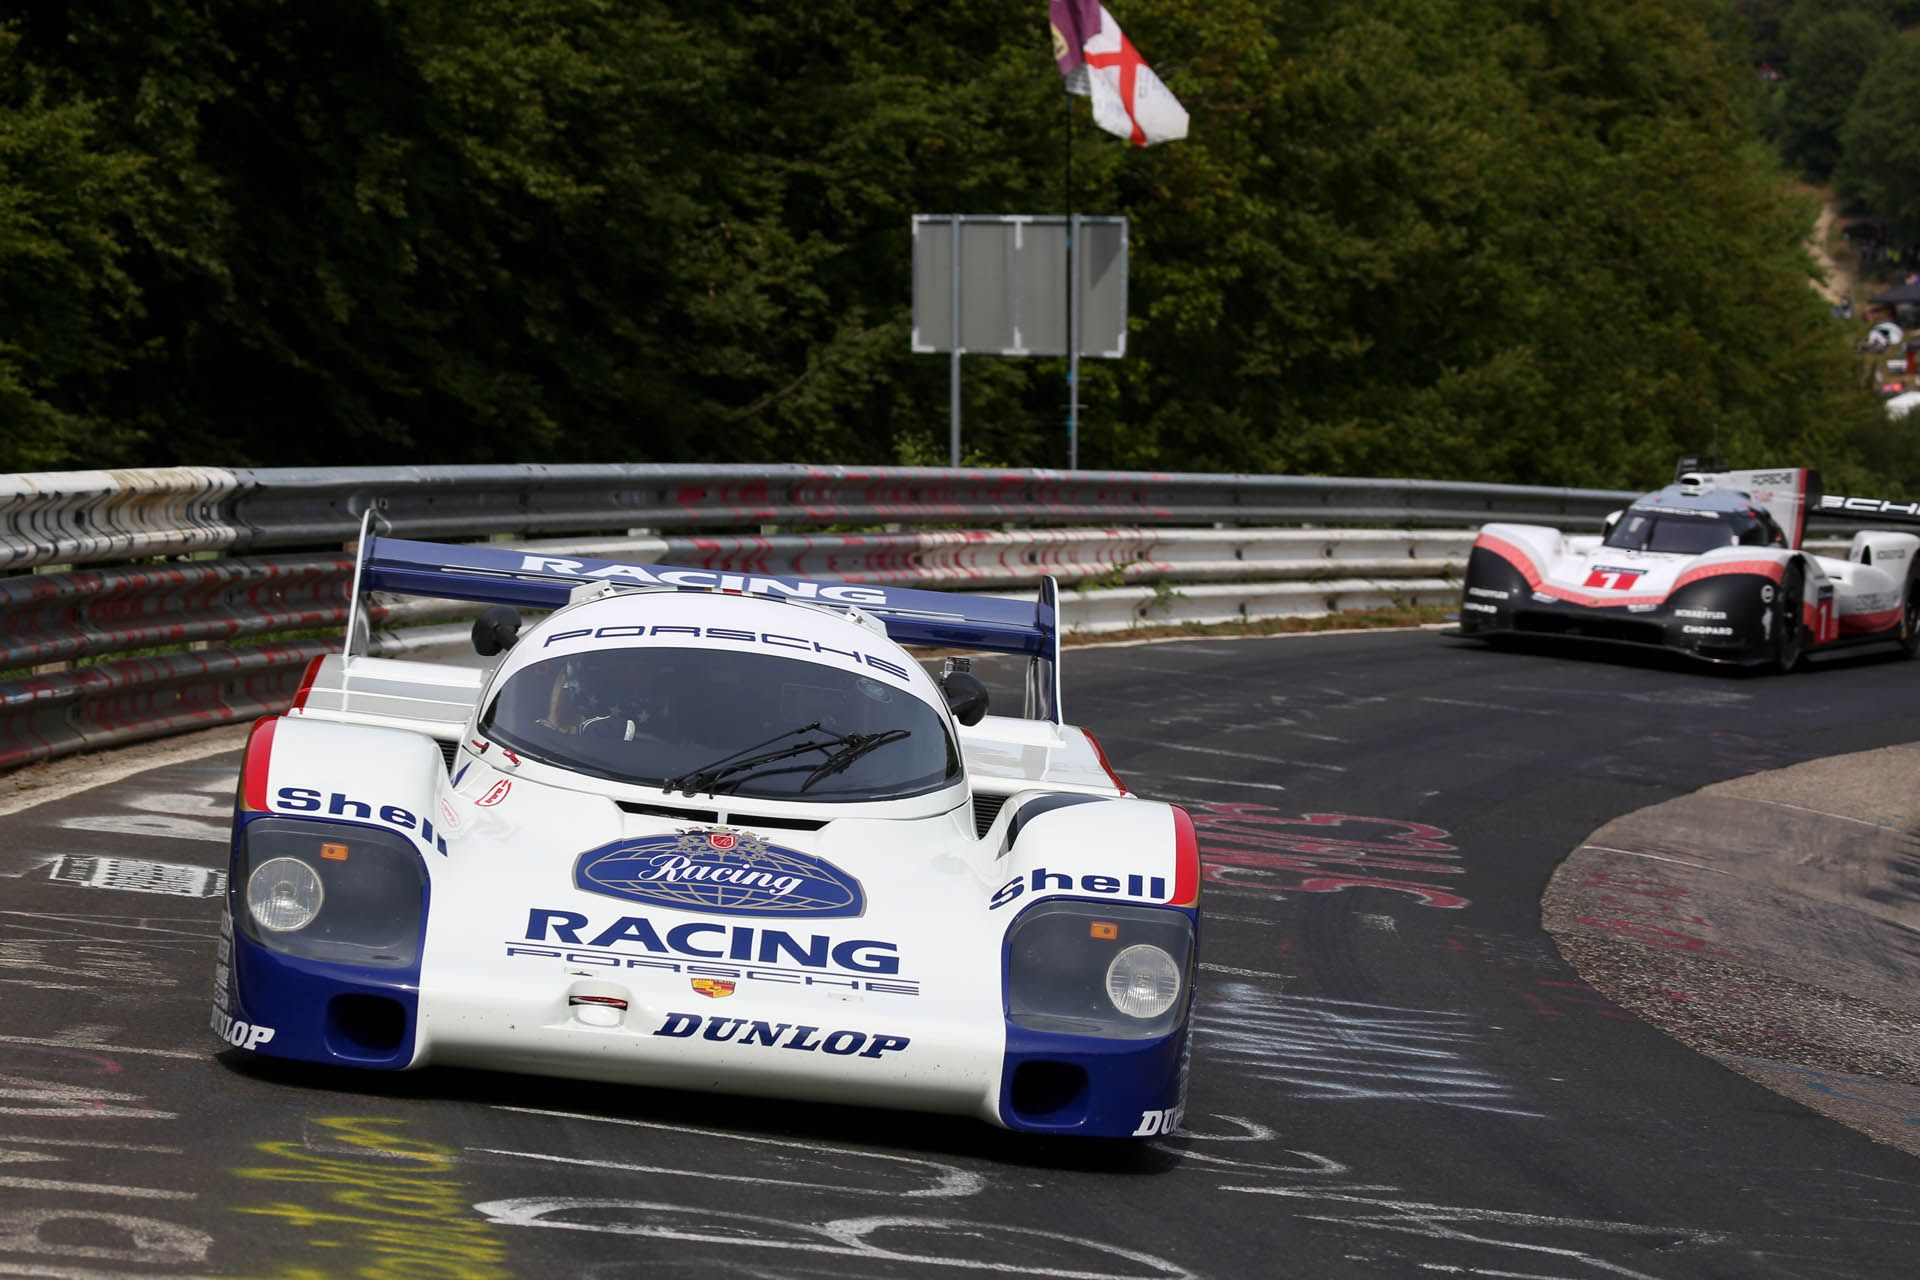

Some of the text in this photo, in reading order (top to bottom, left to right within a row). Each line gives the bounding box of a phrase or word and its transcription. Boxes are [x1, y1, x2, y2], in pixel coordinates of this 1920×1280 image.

[1821, 495, 1920, 516] SCH
[520, 555, 887, 604] RACING
[1600, 573, 1622, 589] 1
[543, 625, 911, 682] PORSCHE
[1682, 624, 1734, 636] CHOPARD
[276, 787, 449, 858] Shell
[638, 854, 804, 897] Racing
[989, 868, 1166, 912] Shell
[524, 908, 900, 976] RACING
[505, 946, 920, 997] PORSCHE
[653, 1012, 911, 1060] DUNLOP
